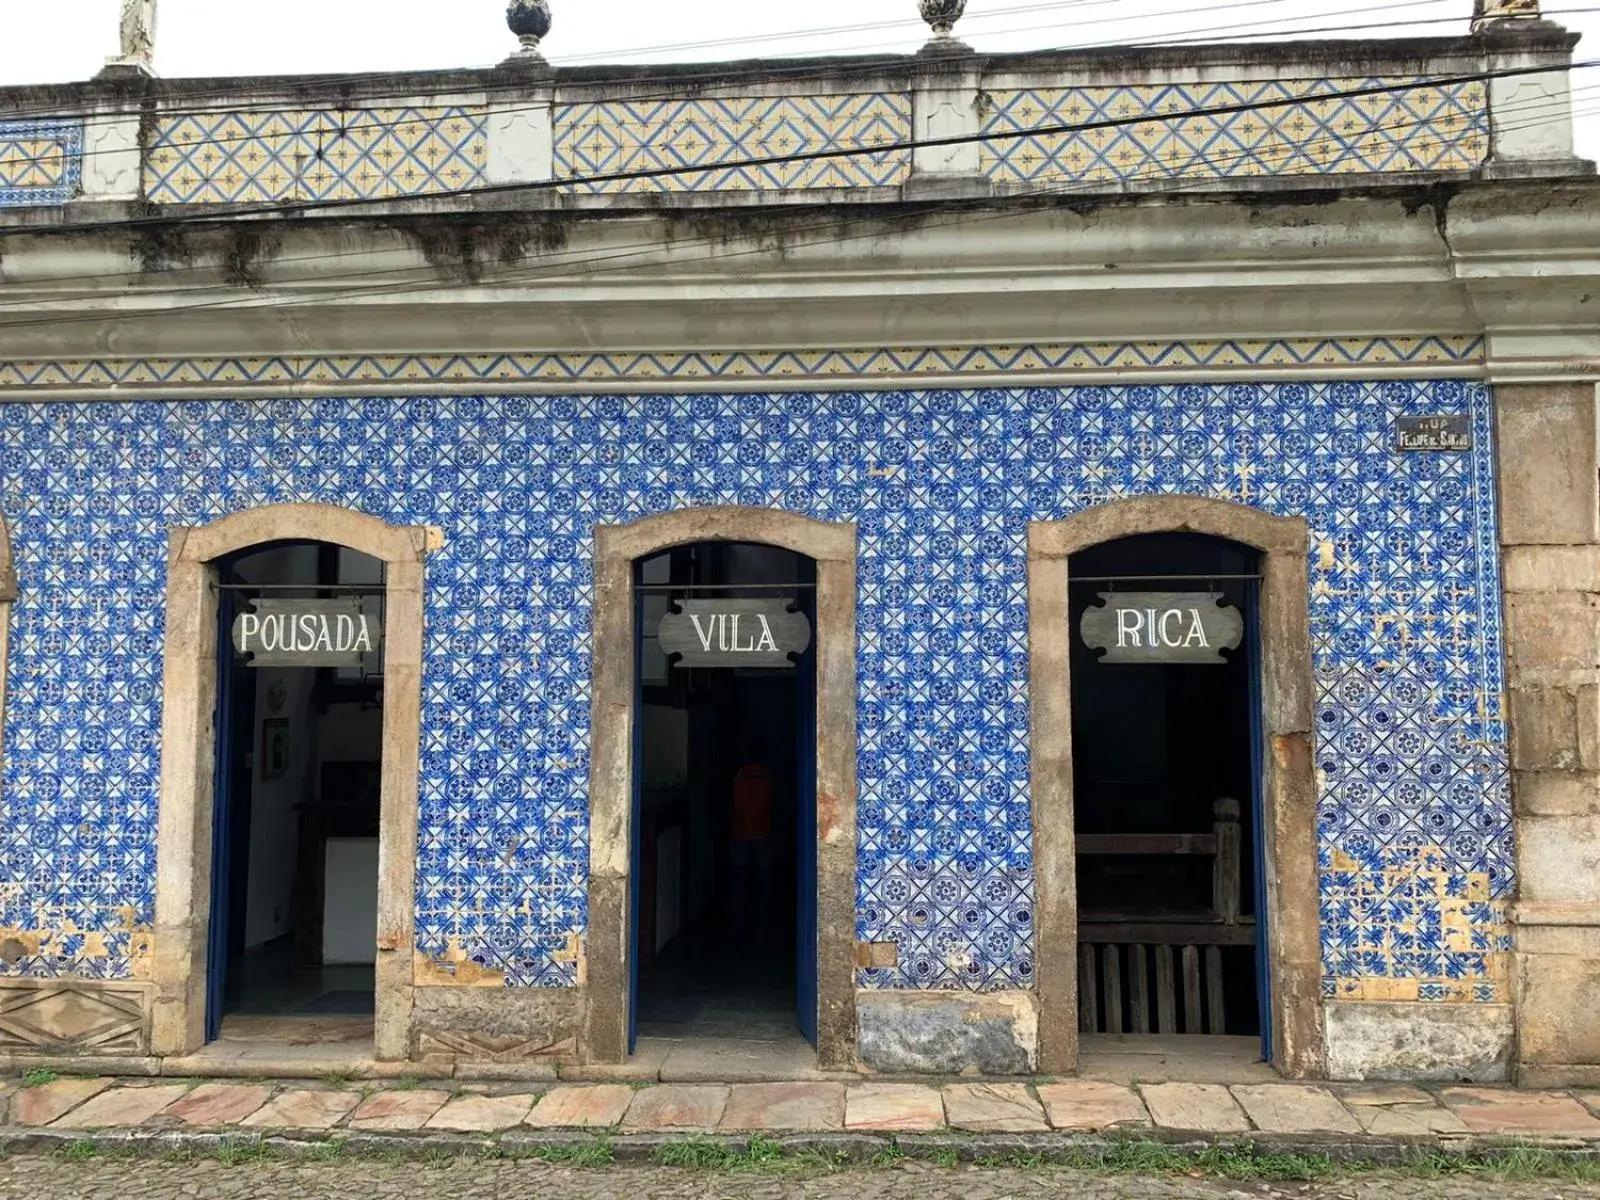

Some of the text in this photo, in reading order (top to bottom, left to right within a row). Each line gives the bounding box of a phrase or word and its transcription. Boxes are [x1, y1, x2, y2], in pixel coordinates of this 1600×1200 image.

[240, 614, 372, 652] POUSADA
[688, 613, 780, 652] VILA
[1115, 608, 1210, 648] RICA
